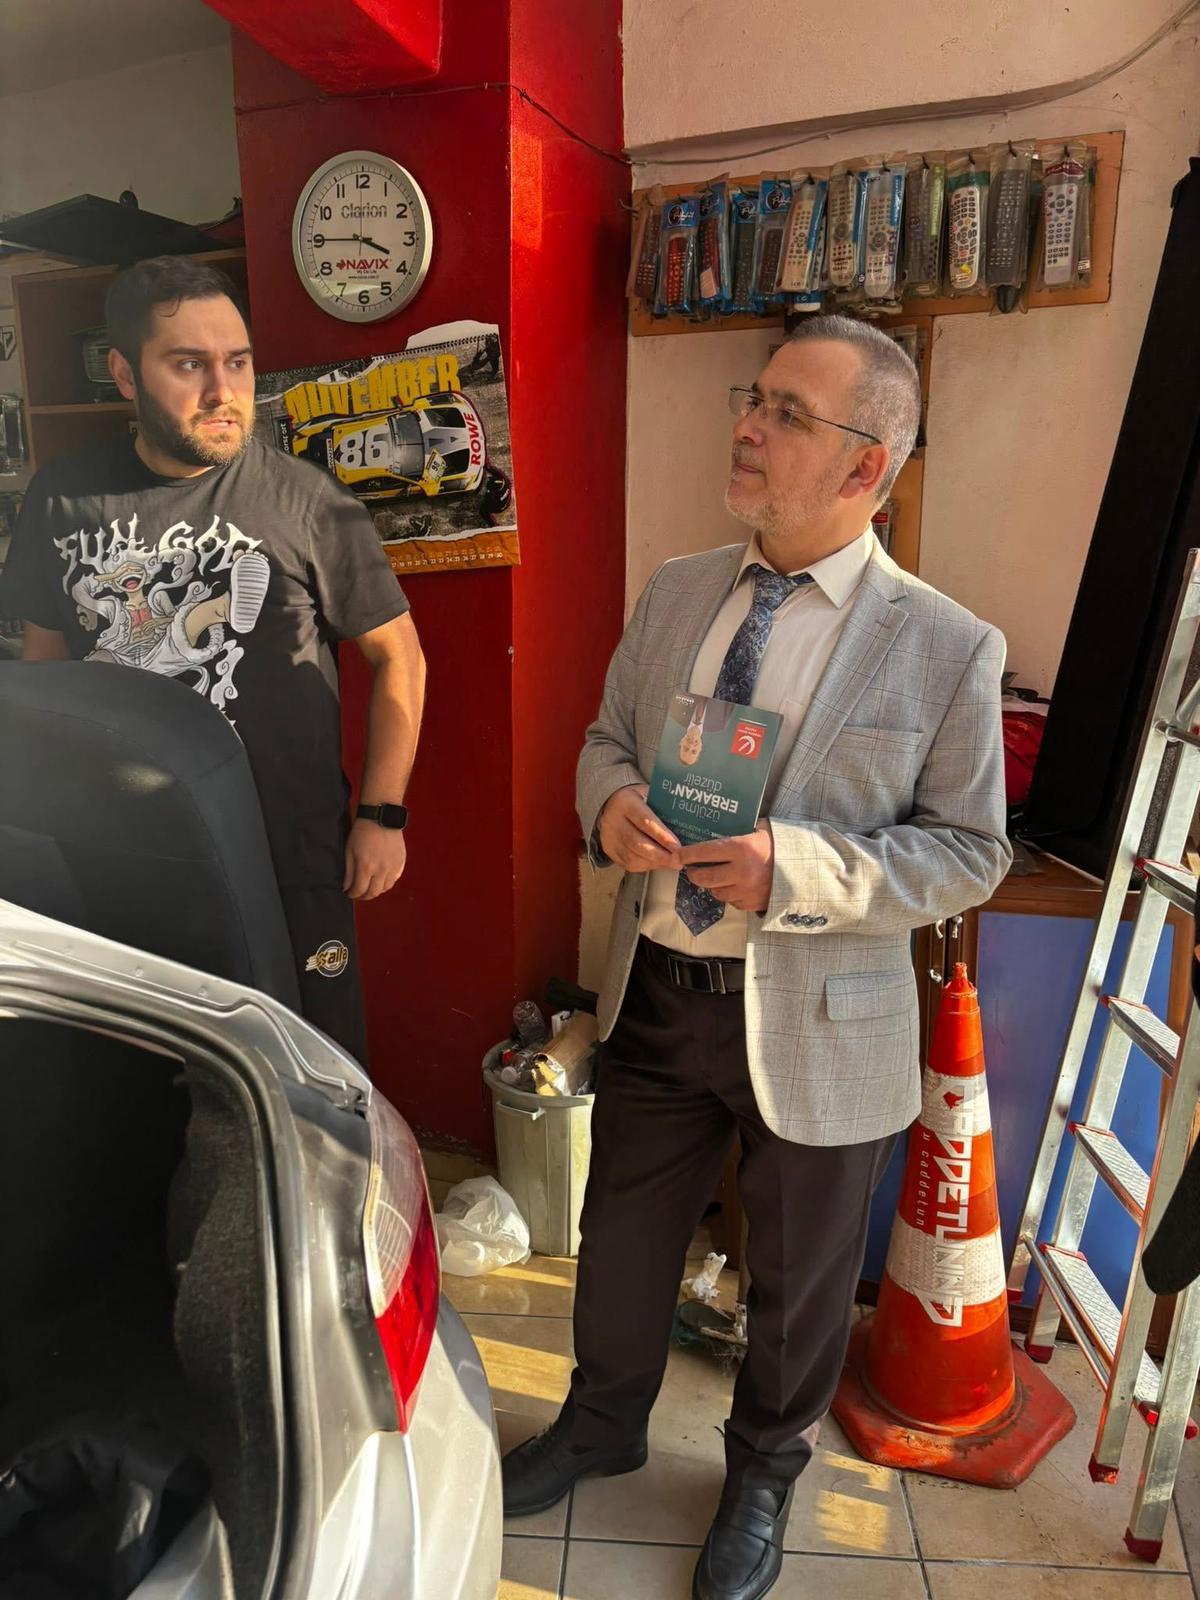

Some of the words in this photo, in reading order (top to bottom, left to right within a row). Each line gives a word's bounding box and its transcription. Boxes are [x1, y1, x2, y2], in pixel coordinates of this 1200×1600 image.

[355, 174, 371, 189] 12
[336, 183, 345, 198] 11
[319, 206, 332, 221] 10
[341, 202, 387, 219] Clarion
[395, 203, 408, 219] 2
[313, 234, 326, 248] 9
[403, 231, 415, 247] 3
[320, 261, 333, 276] 8
[346, 258, 390, 269] NAVIX
[395, 260, 408, 275] 4
[336, 282, 347, 297] 7
[380, 281, 392, 296] 5
[358, 290, 370, 304] 6
[463, 412, 482, 466] ROWE
[683, 772, 722, 793] düzelir
